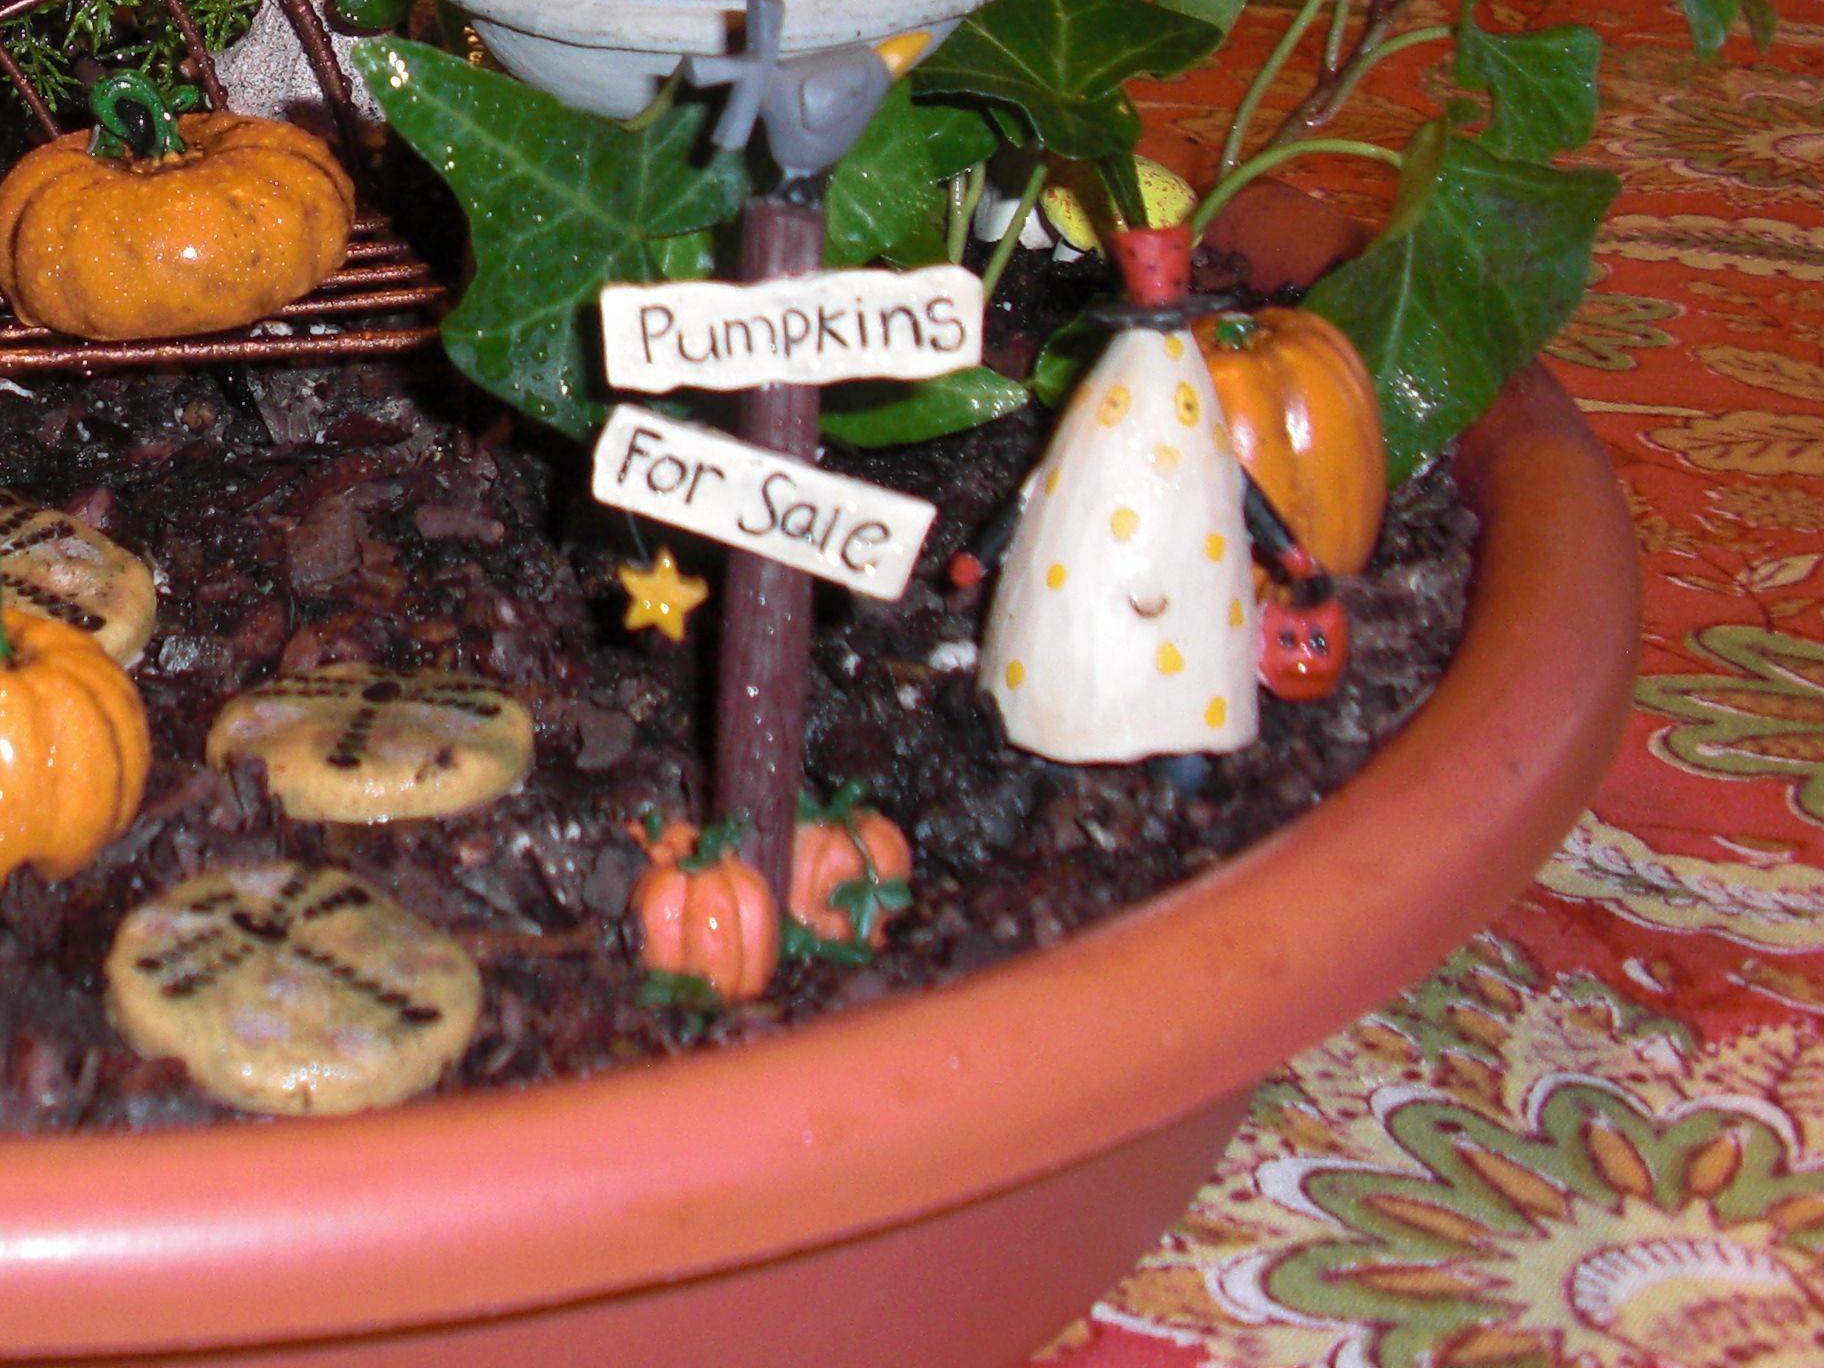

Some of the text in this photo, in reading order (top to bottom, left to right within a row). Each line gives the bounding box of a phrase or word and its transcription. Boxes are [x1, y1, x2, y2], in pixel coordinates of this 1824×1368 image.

[639, 297, 967, 364] Pumpkins
[617, 428, 891, 573] For Sale
